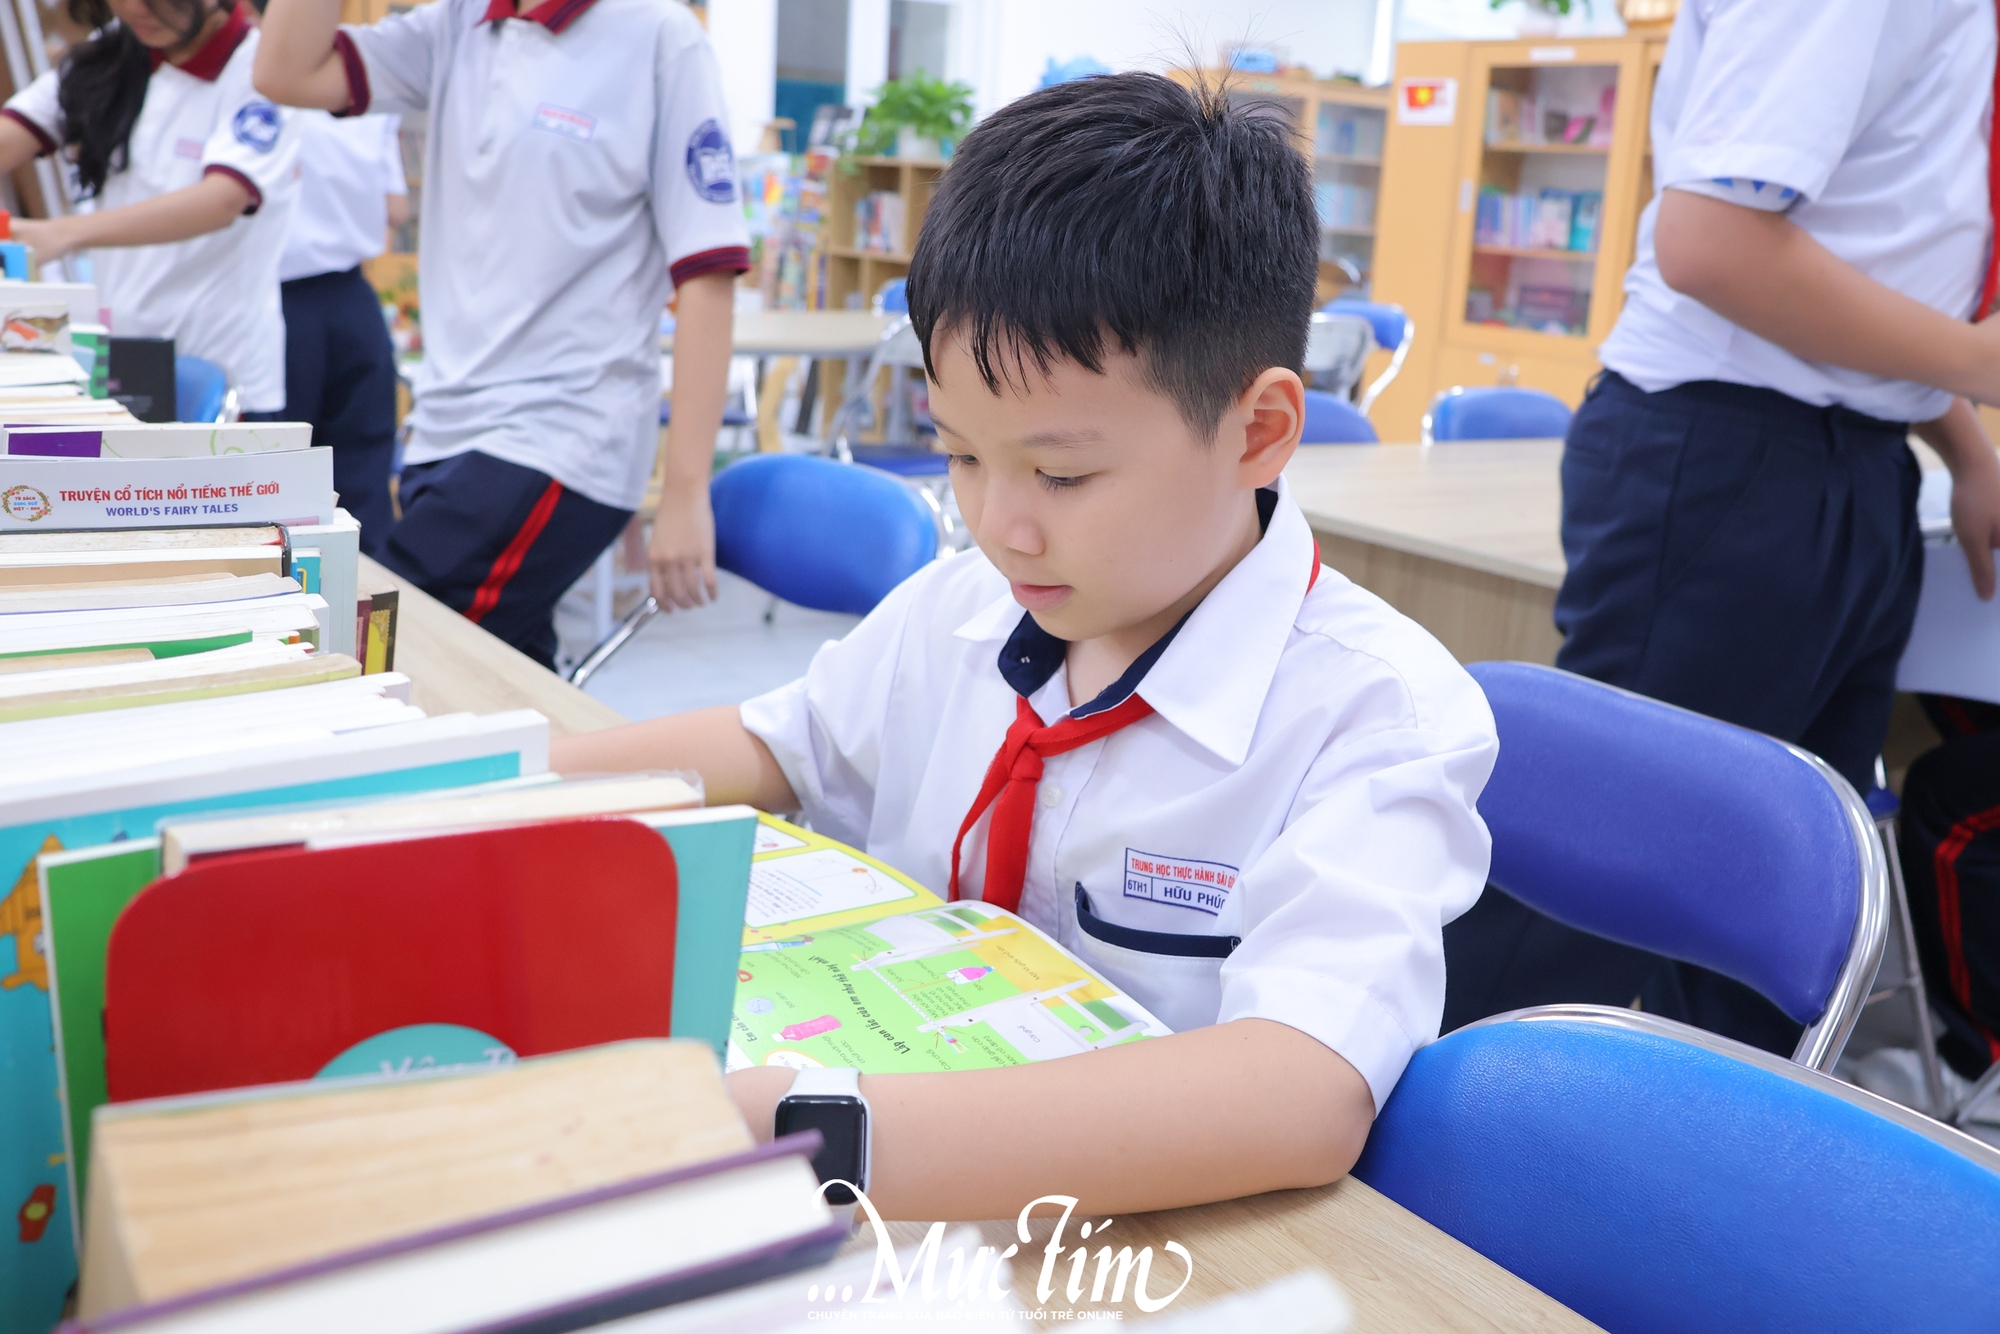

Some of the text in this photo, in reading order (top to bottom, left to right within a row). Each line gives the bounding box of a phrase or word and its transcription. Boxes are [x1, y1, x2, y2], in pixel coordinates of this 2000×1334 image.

[60, 481, 280, 504] TRUYỆN CỔ TÍCH NỔI TIẾNG THẾ GIỚI
[105, 503, 238, 517] WORLD'S FAIRY TALES
[1131, 858, 1154, 874] TRUNG
[1155, 864, 1170, 878] HỌC
[1173, 866, 1192, 882] THỰC
[1194, 867, 1214, 882] HÀNH
[1217, 871, 1227, 886] SÀI
[1128, 879, 1148, 893] 6TH1
[1164, 886, 1192, 901] HỮU
[826, 963, 841, 973] này
[832, 973, 849, 982] thế
[842, 983, 856, 994] như
[849, 996, 862, 1005] em
[856, 1006, 871, 1018] của
[865, 1018, 881, 1030] lắc
[745, 1031, 758, 1042] Em
[878, 1029, 895, 1041] con
[893, 1041, 911, 1054] Lắp
[839, 1052, 853, 1064] pha
[851, 1052, 866, 1064] chút
